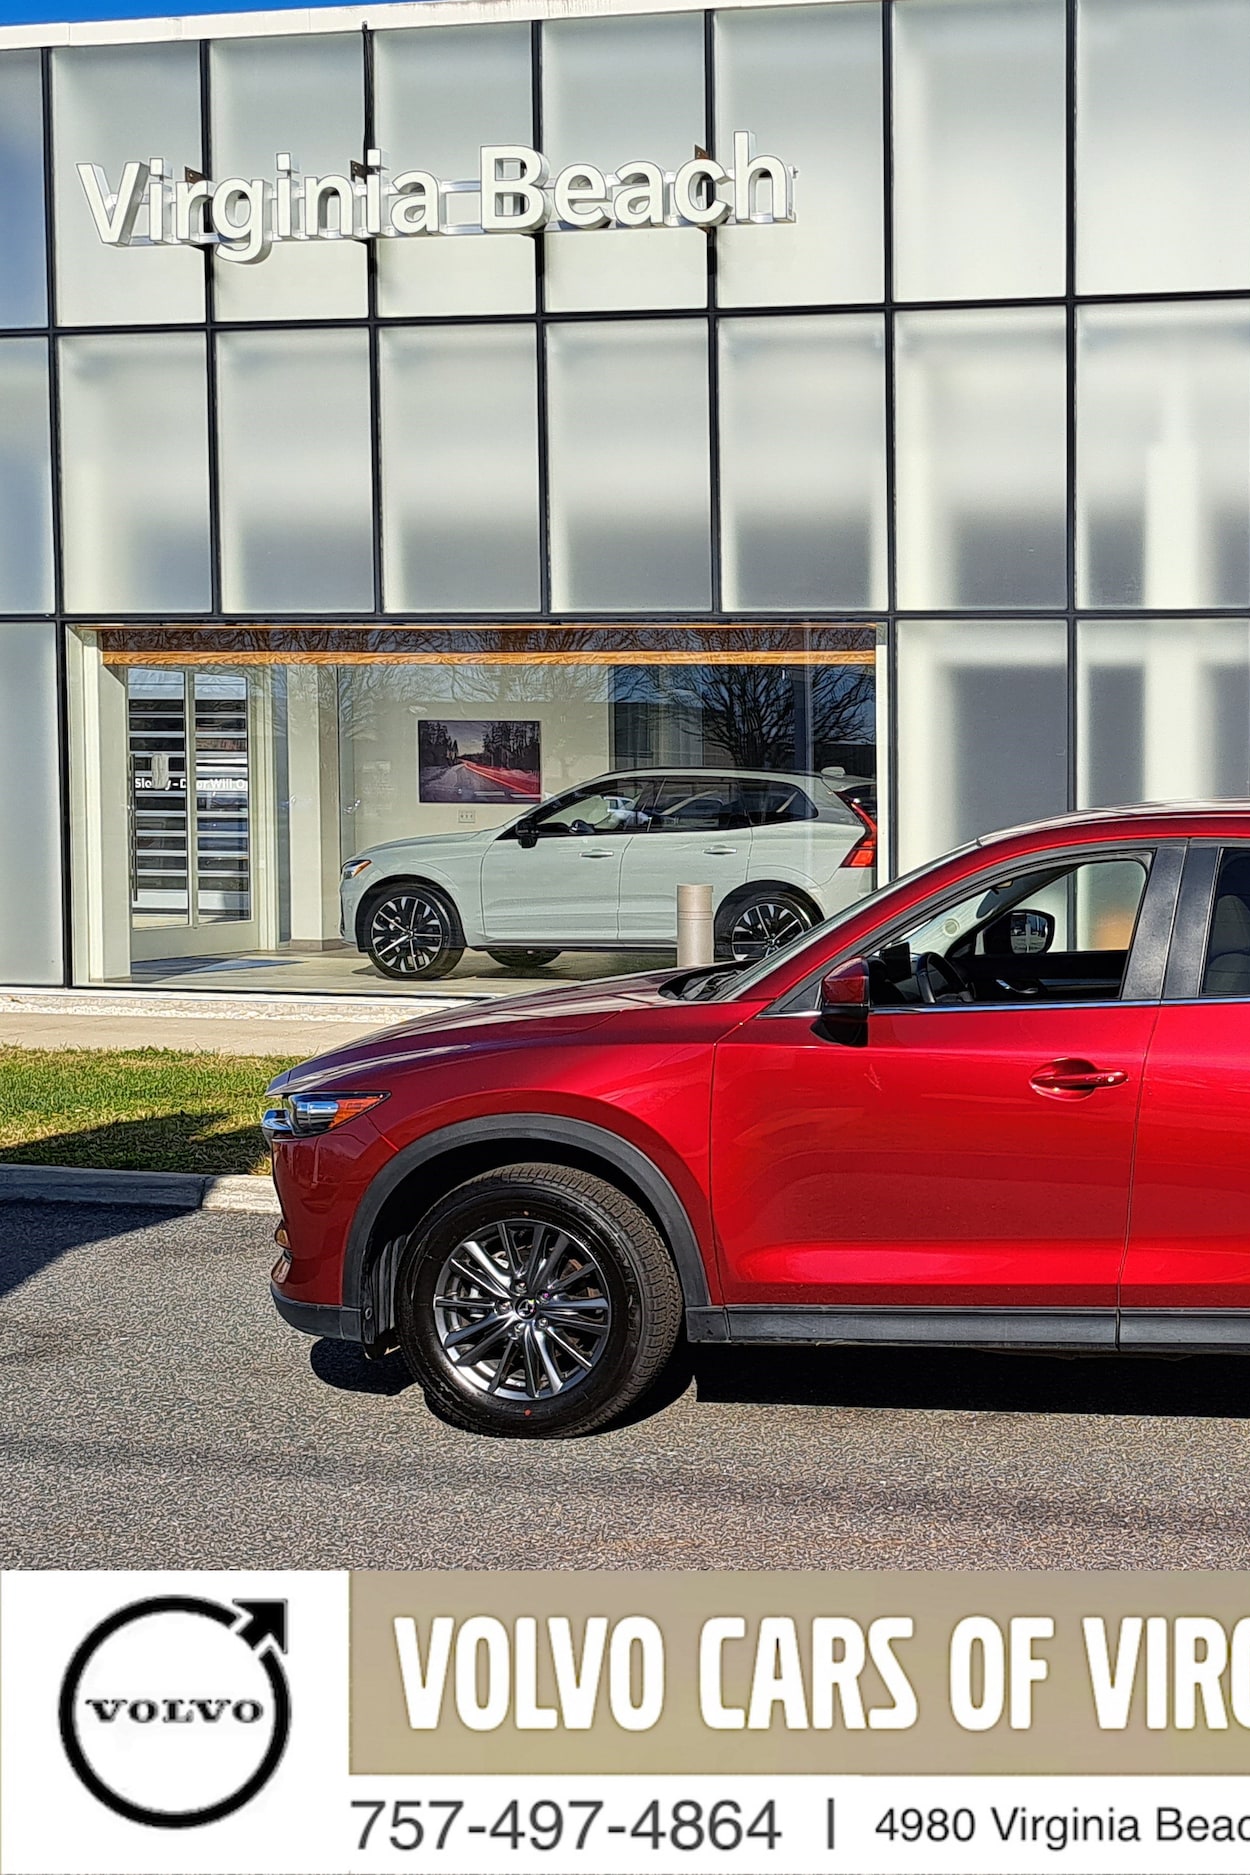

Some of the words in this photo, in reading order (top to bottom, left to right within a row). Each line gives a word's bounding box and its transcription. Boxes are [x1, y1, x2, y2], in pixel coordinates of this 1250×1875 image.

[75, 148, 441, 263] Virginia
[480, 130, 792, 232] Beach
[135, 778, 172, 791] Sloy
